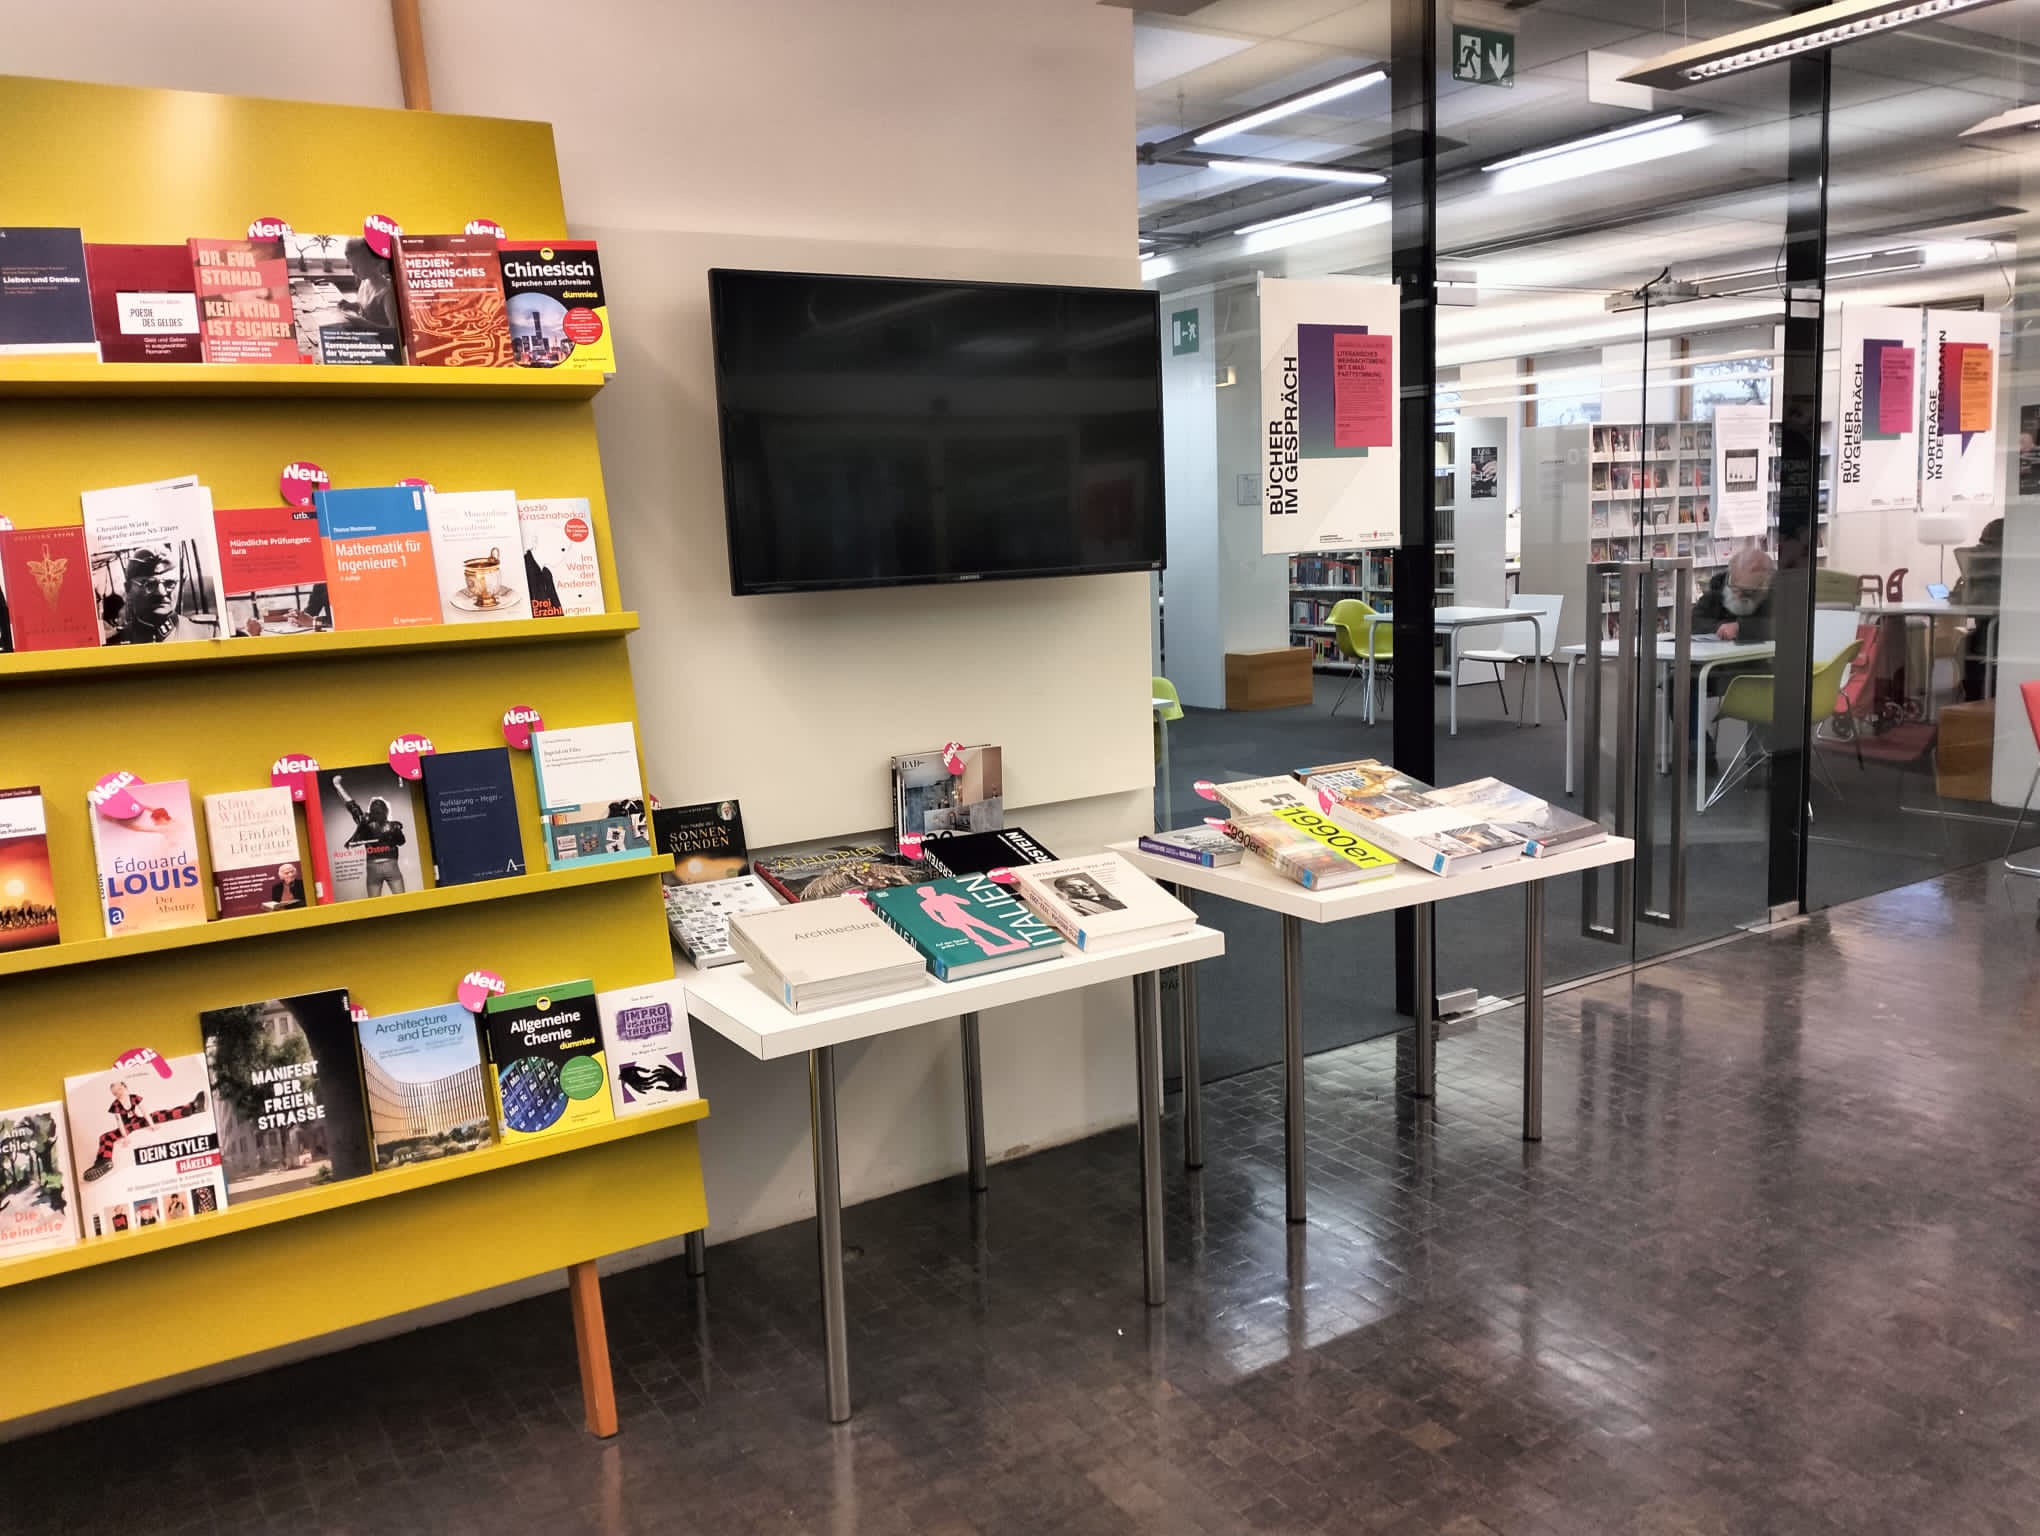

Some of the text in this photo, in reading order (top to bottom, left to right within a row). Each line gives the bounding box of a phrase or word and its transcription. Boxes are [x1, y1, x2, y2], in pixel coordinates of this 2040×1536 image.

[200, 250, 256, 268] DR. EVA
[405, 258, 454, 269] MEDIEN-
[201, 269, 262, 287] STRNAD
[407, 267, 486, 279] TECHNISCHES
[504, 261, 594, 278] Chinesisch
[3, 276, 80, 284] Lieben und Denken
[408, 278, 454, 289] WISSEN
[512, 278, 591, 288] Sprechen und Schreiben
[562, 290, 598, 299] dummies
[204, 301, 280, 319] KEIN KIND
[207, 320, 291, 338] IST SICHER
[1852, 363, 1863, 483] IM GESPRÄCH
[1281, 356, 1298, 515] IM GESPRÄCH
[1926, 390, 1938, 480] VORTRÄGE
[1841, 411, 1854, 483] BÜCHER
[1266, 420, 1284, 515] BÜCHER
[1935, 464, 1943, 479] IN
[230, 538, 268, 547] Mündliche
[336, 539, 421, 557] Mathematik für
[337, 555, 407, 574] Ingenieure 1
[567, 562, 594, 572] Wahn
[581, 554, 593, 562] Im
[557, 579, 597, 589] Anderen
[580, 571, 595, 579] der
[533, 606, 591, 617] Erzählungen
[503, 710, 540, 726] Neu!
[390, 738, 434, 755] Neu!
[272, 758, 320, 775] Neu!
[219, 805, 288, 823] Willbrand
[239, 824, 291, 843] Einfach
[670, 825, 731, 842] SONNEN-
[1283, 808, 1381, 864] 1990er
[230, 838, 292, 856] Literatur
[670, 836, 729, 853] WENDEN
[114, 851, 187, 874] Édouard
[108, 866, 199, 898] LOUIS
[155, 896, 174, 905] Der
[957, 873, 1064, 947] ITALIEN
[794, 920, 882, 941] Architecture
[510, 1011, 581, 1035] Allgemeine
[626, 1006, 666, 1022] IMPRO
[375, 1013, 447, 1034] Architecture
[397, 1022, 462, 1042] and Energy
[627, 1023, 667, 1038] THEATER
[523, 1027, 573, 1047] Chemie
[559, 1037, 596, 1050] dummies
[252, 1060, 318, 1086] MANIFEST
[274, 1079, 302, 1097] DER
[264, 1092, 315, 1113] FREIEN
[258, 1105, 326, 1130] STRASSE
[4, 1127, 26, 1139] Ann
[0, 1140, 38, 1154] chlee
[138, 1135, 210, 1164] DEIN STYLE!
[180, 1156, 213, 1172] HÄKELN
[15, 1210, 39, 1223] Die
[1, 1222, 63, 1241] heinreise
